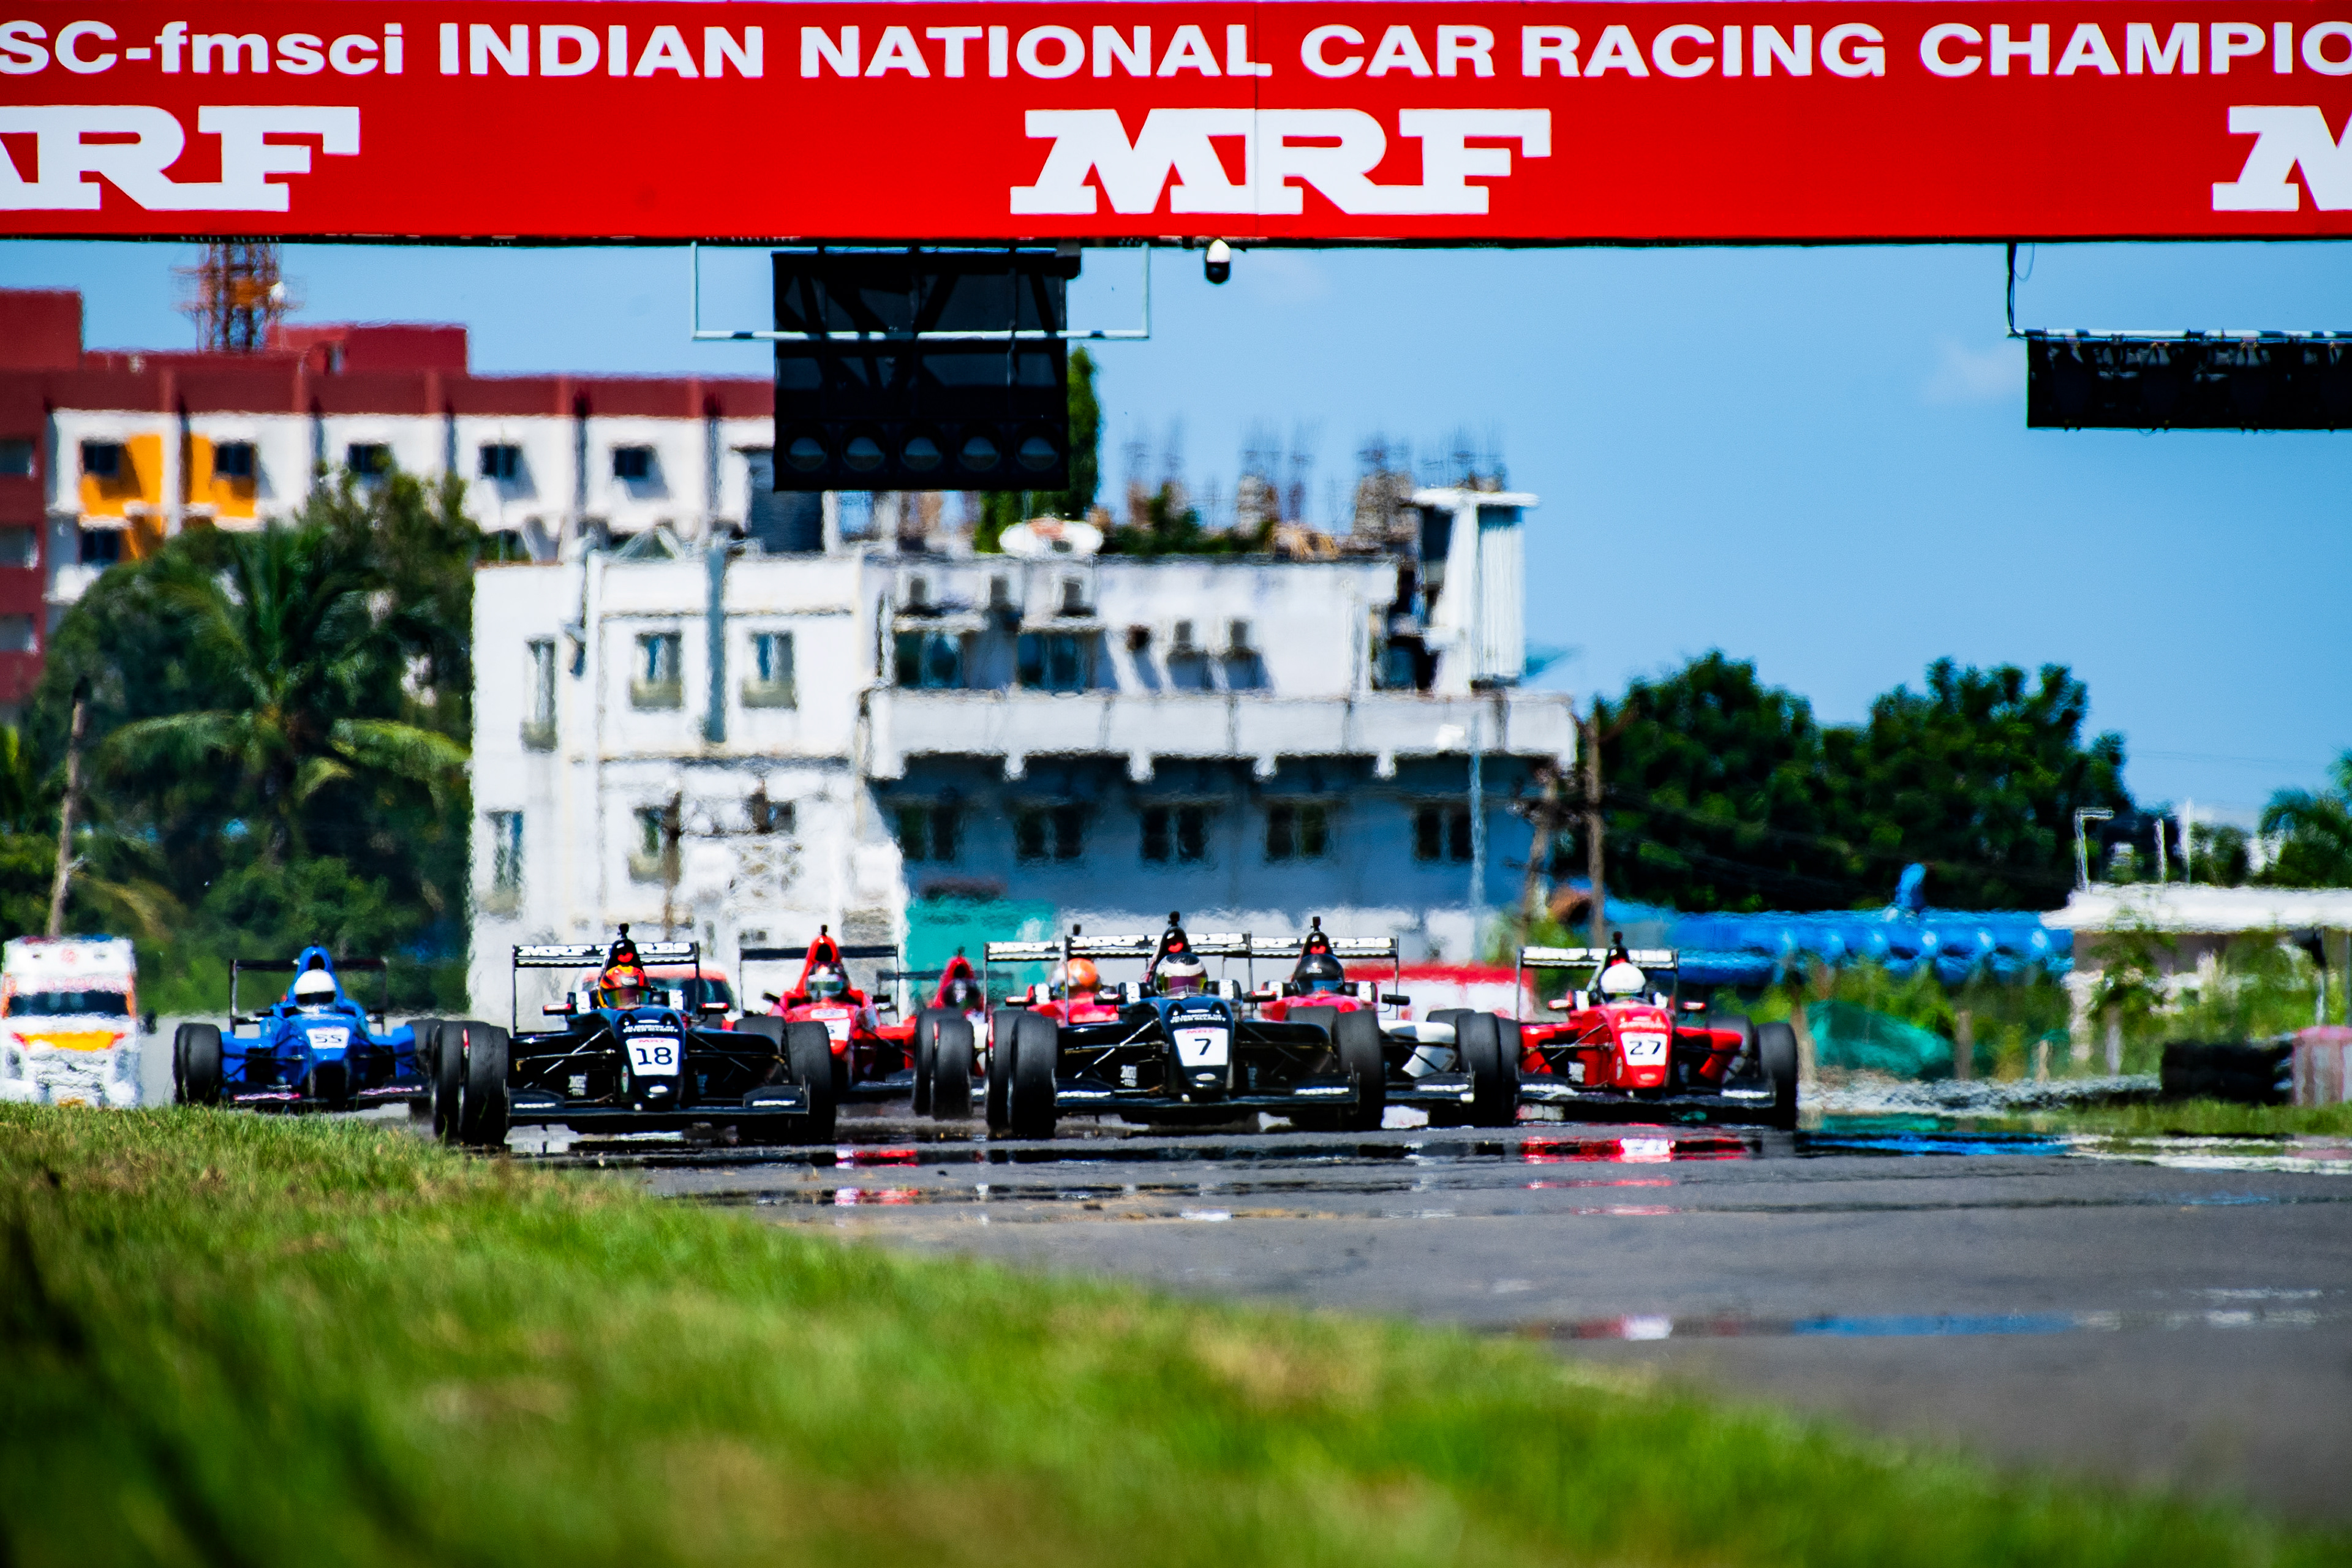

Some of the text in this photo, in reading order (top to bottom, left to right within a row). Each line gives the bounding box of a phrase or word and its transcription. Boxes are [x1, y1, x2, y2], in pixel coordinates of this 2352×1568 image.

[440, 23, 763, 77] INDIAN
[801, 24, 1272, 78] NATIONAL
[1301, 24, 1495, 77] CAR
[1523, 23, 1885, 77] RACING
[0, 105, 360, 211] RF
[1010, 108, 1551, 215] MRF
[518, 944, 592, 957] MRF
[1194, 1038, 1212, 1055] 7
[1629, 1039, 1661, 1055] 27
[636, 1047, 673, 1065] 18
